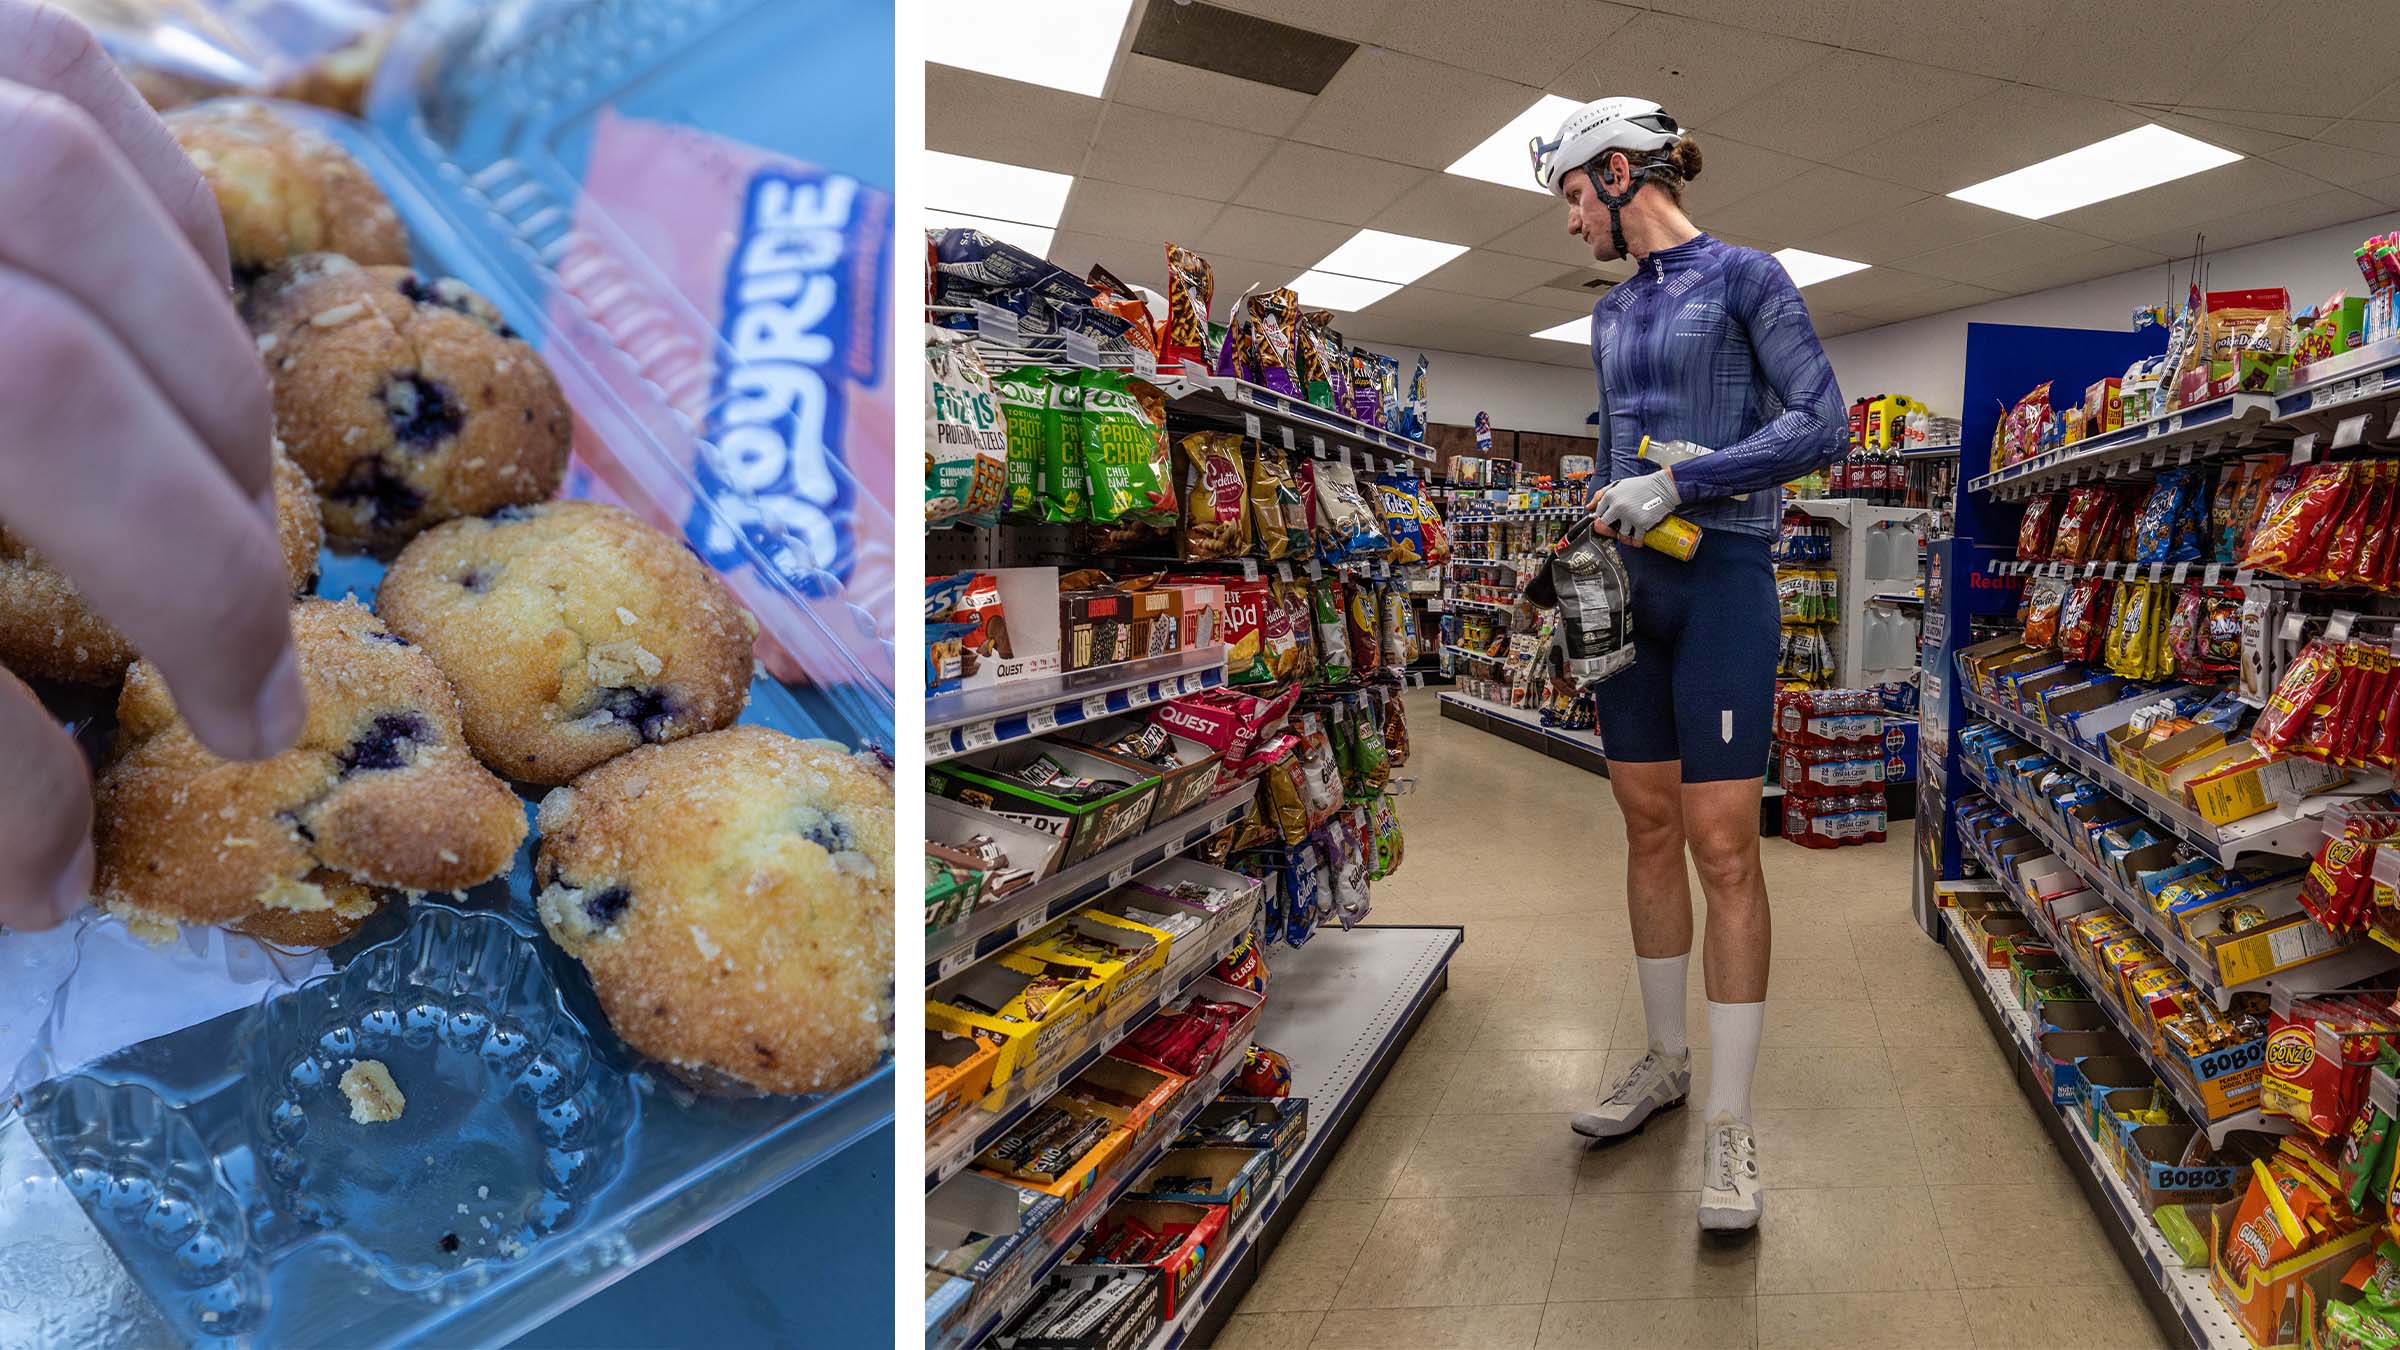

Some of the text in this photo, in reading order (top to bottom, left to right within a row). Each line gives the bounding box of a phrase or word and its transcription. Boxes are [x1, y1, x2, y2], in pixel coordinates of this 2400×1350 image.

[1580, 116, 1610, 135] SCOTT
[704, 172, 860, 584] JOYRIDE
[1008, 409, 1041, 420] TORTILLA
[938, 423, 1006, 451] PROTEIN PRETZELS
[1009, 462, 1033, 474] CHILI
[1106, 467, 1130, 480] CHILI
[1009, 474, 1031, 486] LIME
[1971, 572, 2002, 590] Red
[2210, 618, 2242, 634] PANDA
[996, 663, 1024, 678] QUEST
[1159, 705, 1220, 735] QUEST
[1887, 736, 1905, 744] PEPSI
[1887, 765, 1905, 774] PEPSI
[2200, 1039, 2266, 1079] BOBO'
[2267, 1043, 2316, 1065] GONZO
[2219, 1073, 2243, 1085] PEANUT
[2220, 1078, 2254, 1091] CHOCOLATE
[2266, 1077, 2299, 1095] Lemon Drops
[989, 1137, 1024, 1161] KIND
[1033, 1147, 1061, 1174] KIND
[2158, 1167, 2231, 1189] BOBO'S
[1230, 1194, 1251, 1226] KIND
[974, 1257, 993, 1274] 12
[1179, 1262, 1205, 1291] KIND
